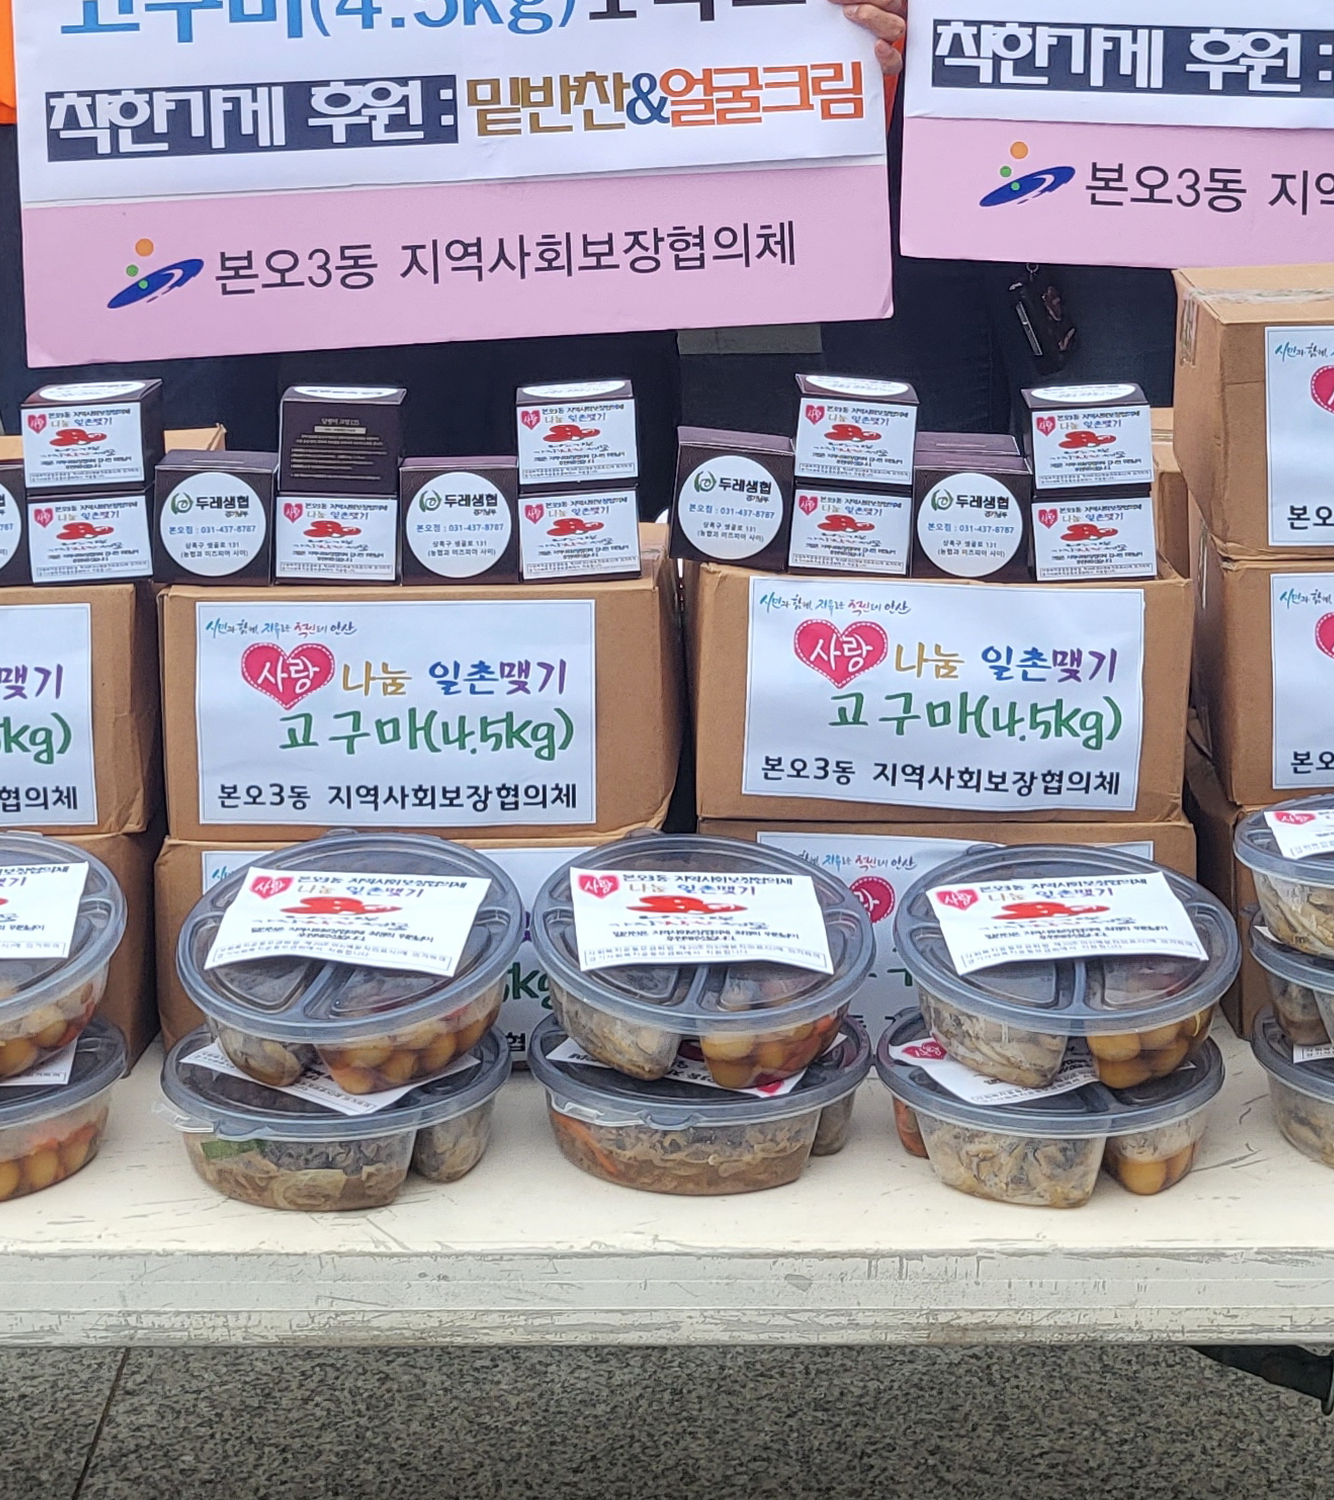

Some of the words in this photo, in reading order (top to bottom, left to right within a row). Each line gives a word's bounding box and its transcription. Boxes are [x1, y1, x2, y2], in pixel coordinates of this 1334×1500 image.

[936, 23, 1162, 89] 착한가게
[50, 88, 284, 154] 착한가게
[1086, 163, 1246, 214] 본오3동
[215, 244, 377, 295] 본오3동
[400, 221, 797, 284] 지역사회보장협의체
[195, 495, 249, 509] 두레생협
[445, 494, 497, 508] 두레생협
[719, 477, 771, 495] 두레생협
[956, 496, 1009, 509] 두레생협
[257, 656, 320, 693] 사랑
[343, 661, 412, 696] 나눔
[429, 659, 567, 695] 일촌맺기
[810, 634, 874, 671] 사랑
[895, 643, 965, 679] 나눔
[981, 646, 1117, 684] 일촌맺기
[280, 707, 573, 761] 고구마(4.5kg)
[829, 691, 1122, 750] 고구마(4.5kg)
[218, 783, 311, 810] 본오3동
[328, 783, 577, 811] 지역사회보장협의체
[761, 755, 855, 786] 본오3동
[873, 761, 1120, 796] 지역사회보장협의체
